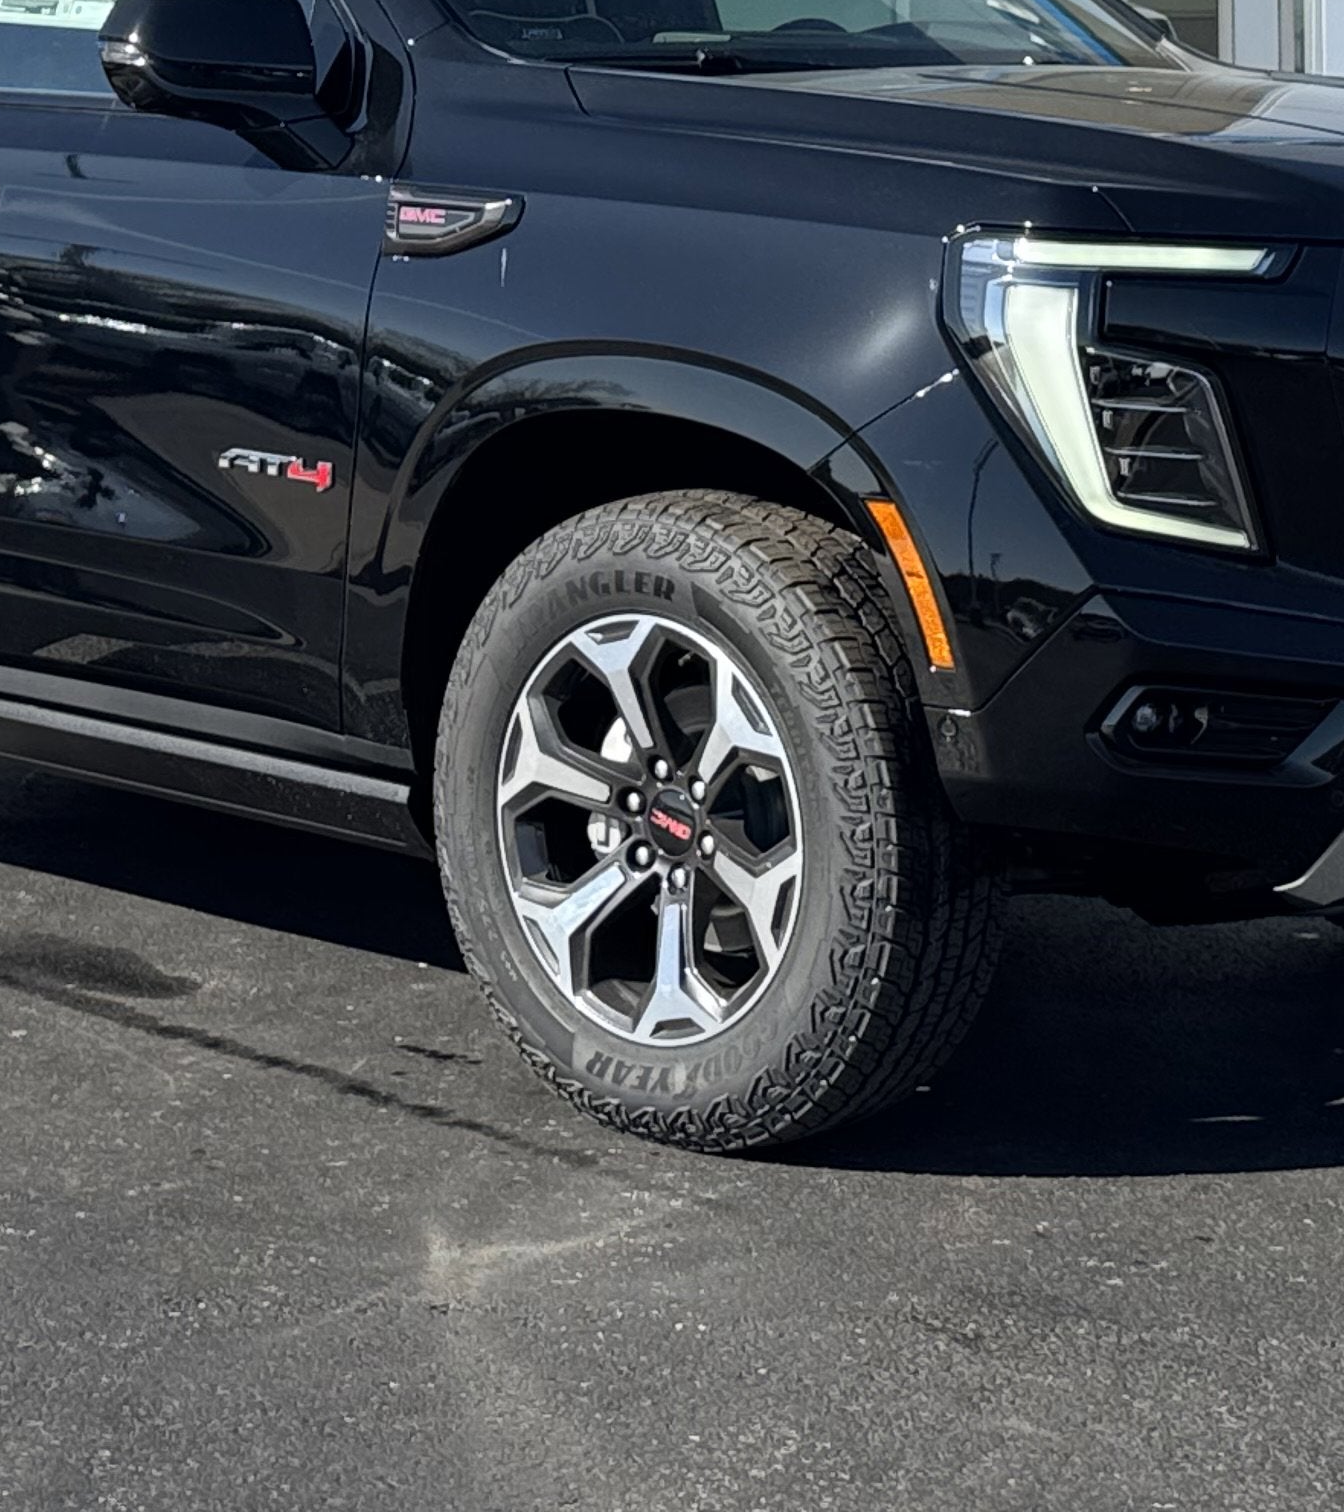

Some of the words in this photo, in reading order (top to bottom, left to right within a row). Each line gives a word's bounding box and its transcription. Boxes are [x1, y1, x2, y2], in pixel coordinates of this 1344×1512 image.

[399, 206, 446, 224] GMC
[218, 448, 333, 492] AT4
[650, 807, 692, 840] GMC
[585, 1020, 778, 1100] GOODYEAR
